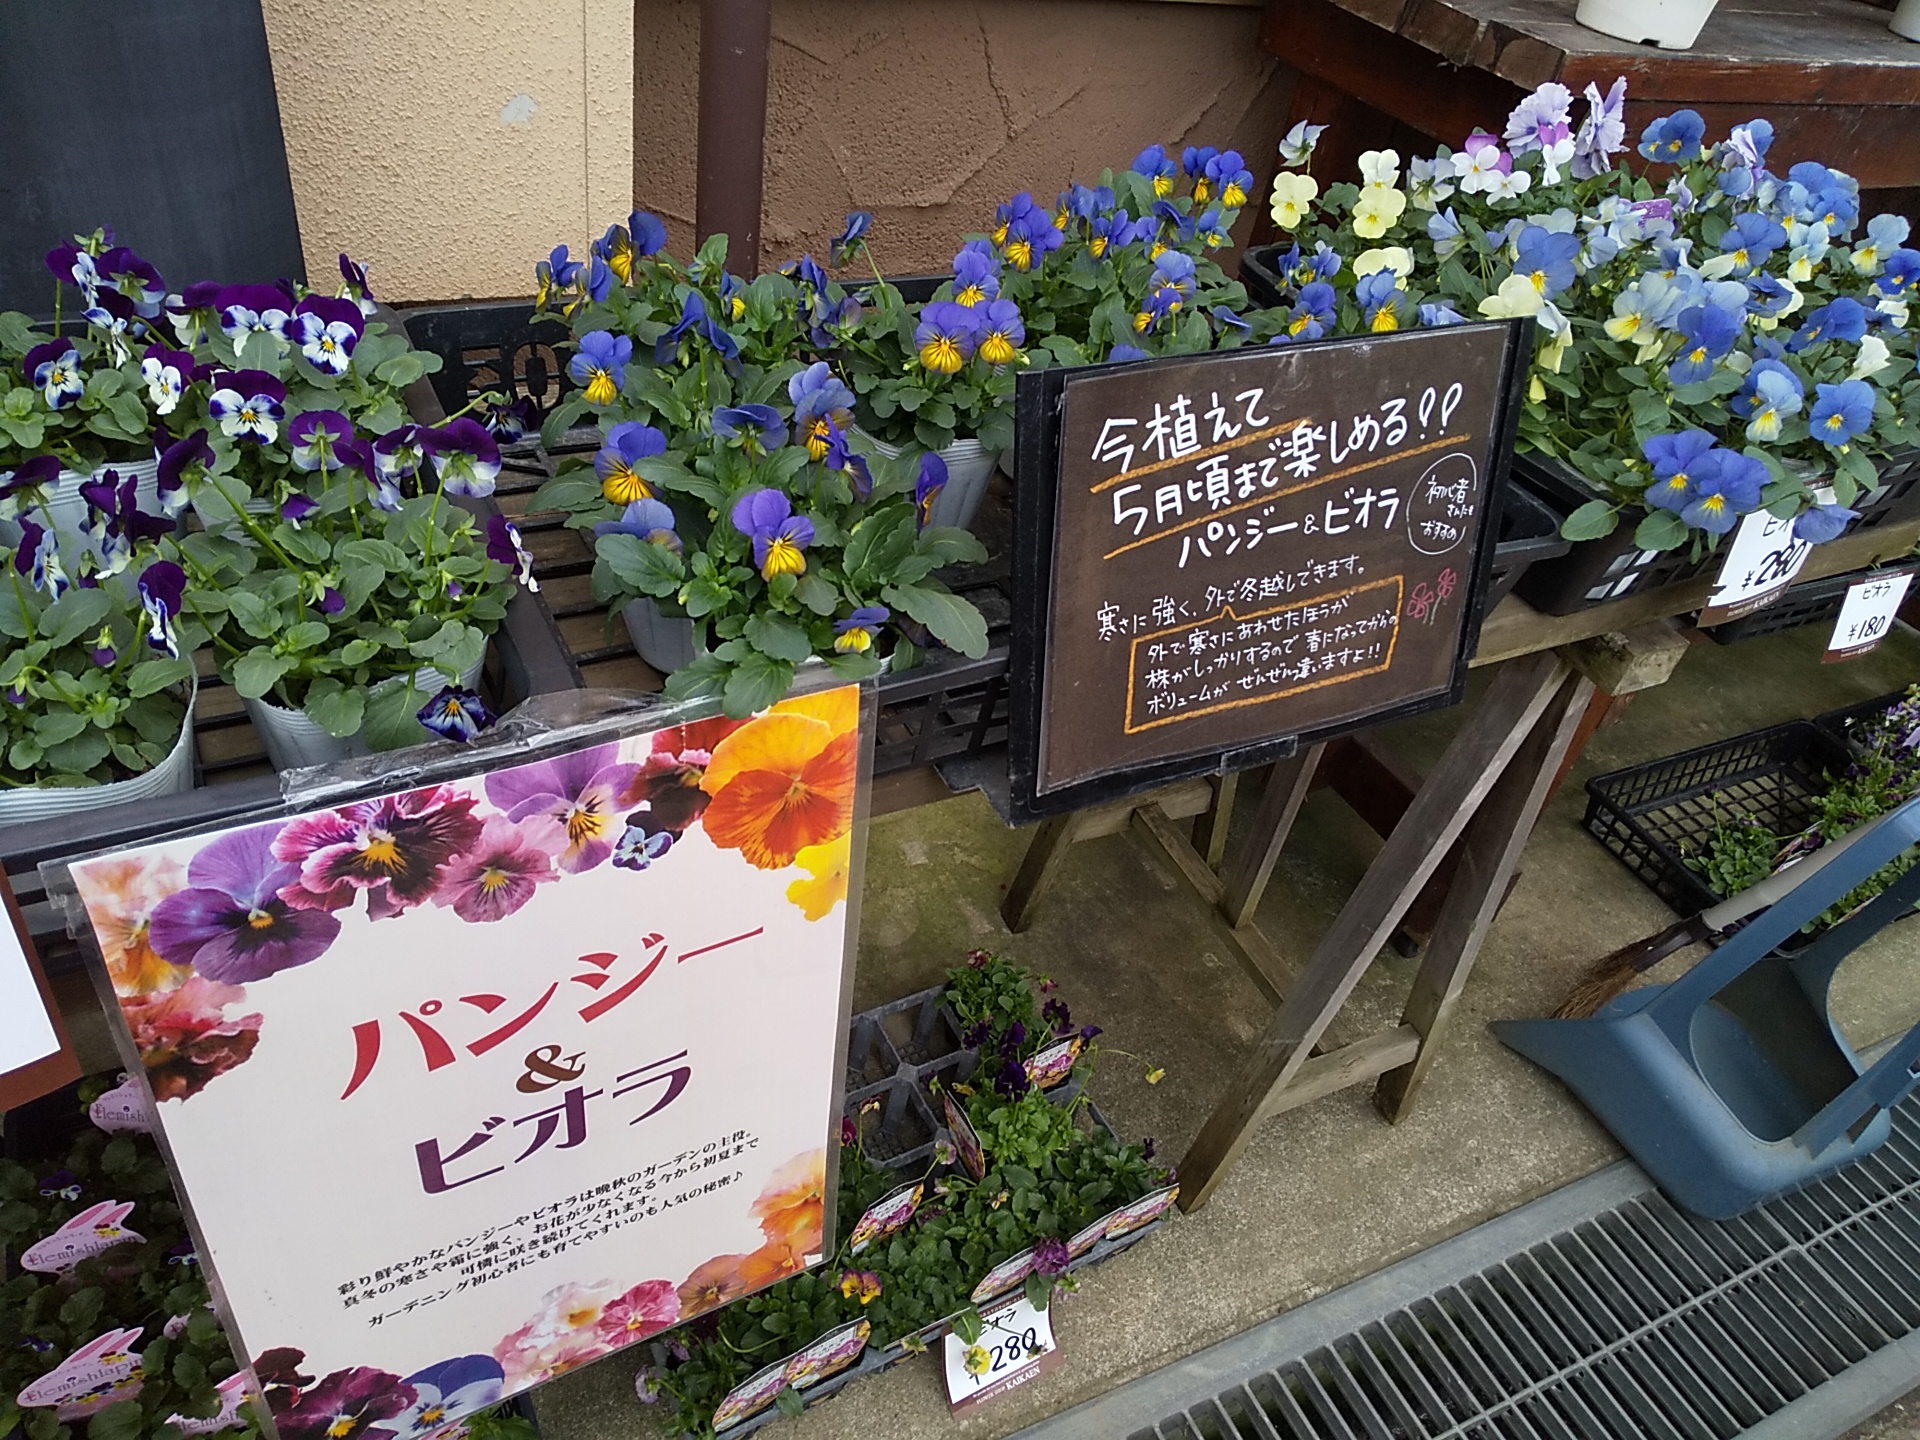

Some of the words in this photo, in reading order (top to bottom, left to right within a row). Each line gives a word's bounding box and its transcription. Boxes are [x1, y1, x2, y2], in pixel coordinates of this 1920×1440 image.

[1091, 387, 1270, 474] 今植えて
[1862, 581, 1892, 600] ビオラ
[1848, 614, 1887, 641] ¥180
[340, 926, 764, 1100] パンジー
[516, 1044, 586, 1094] &
[415, 1049, 692, 1194] ビオラ
